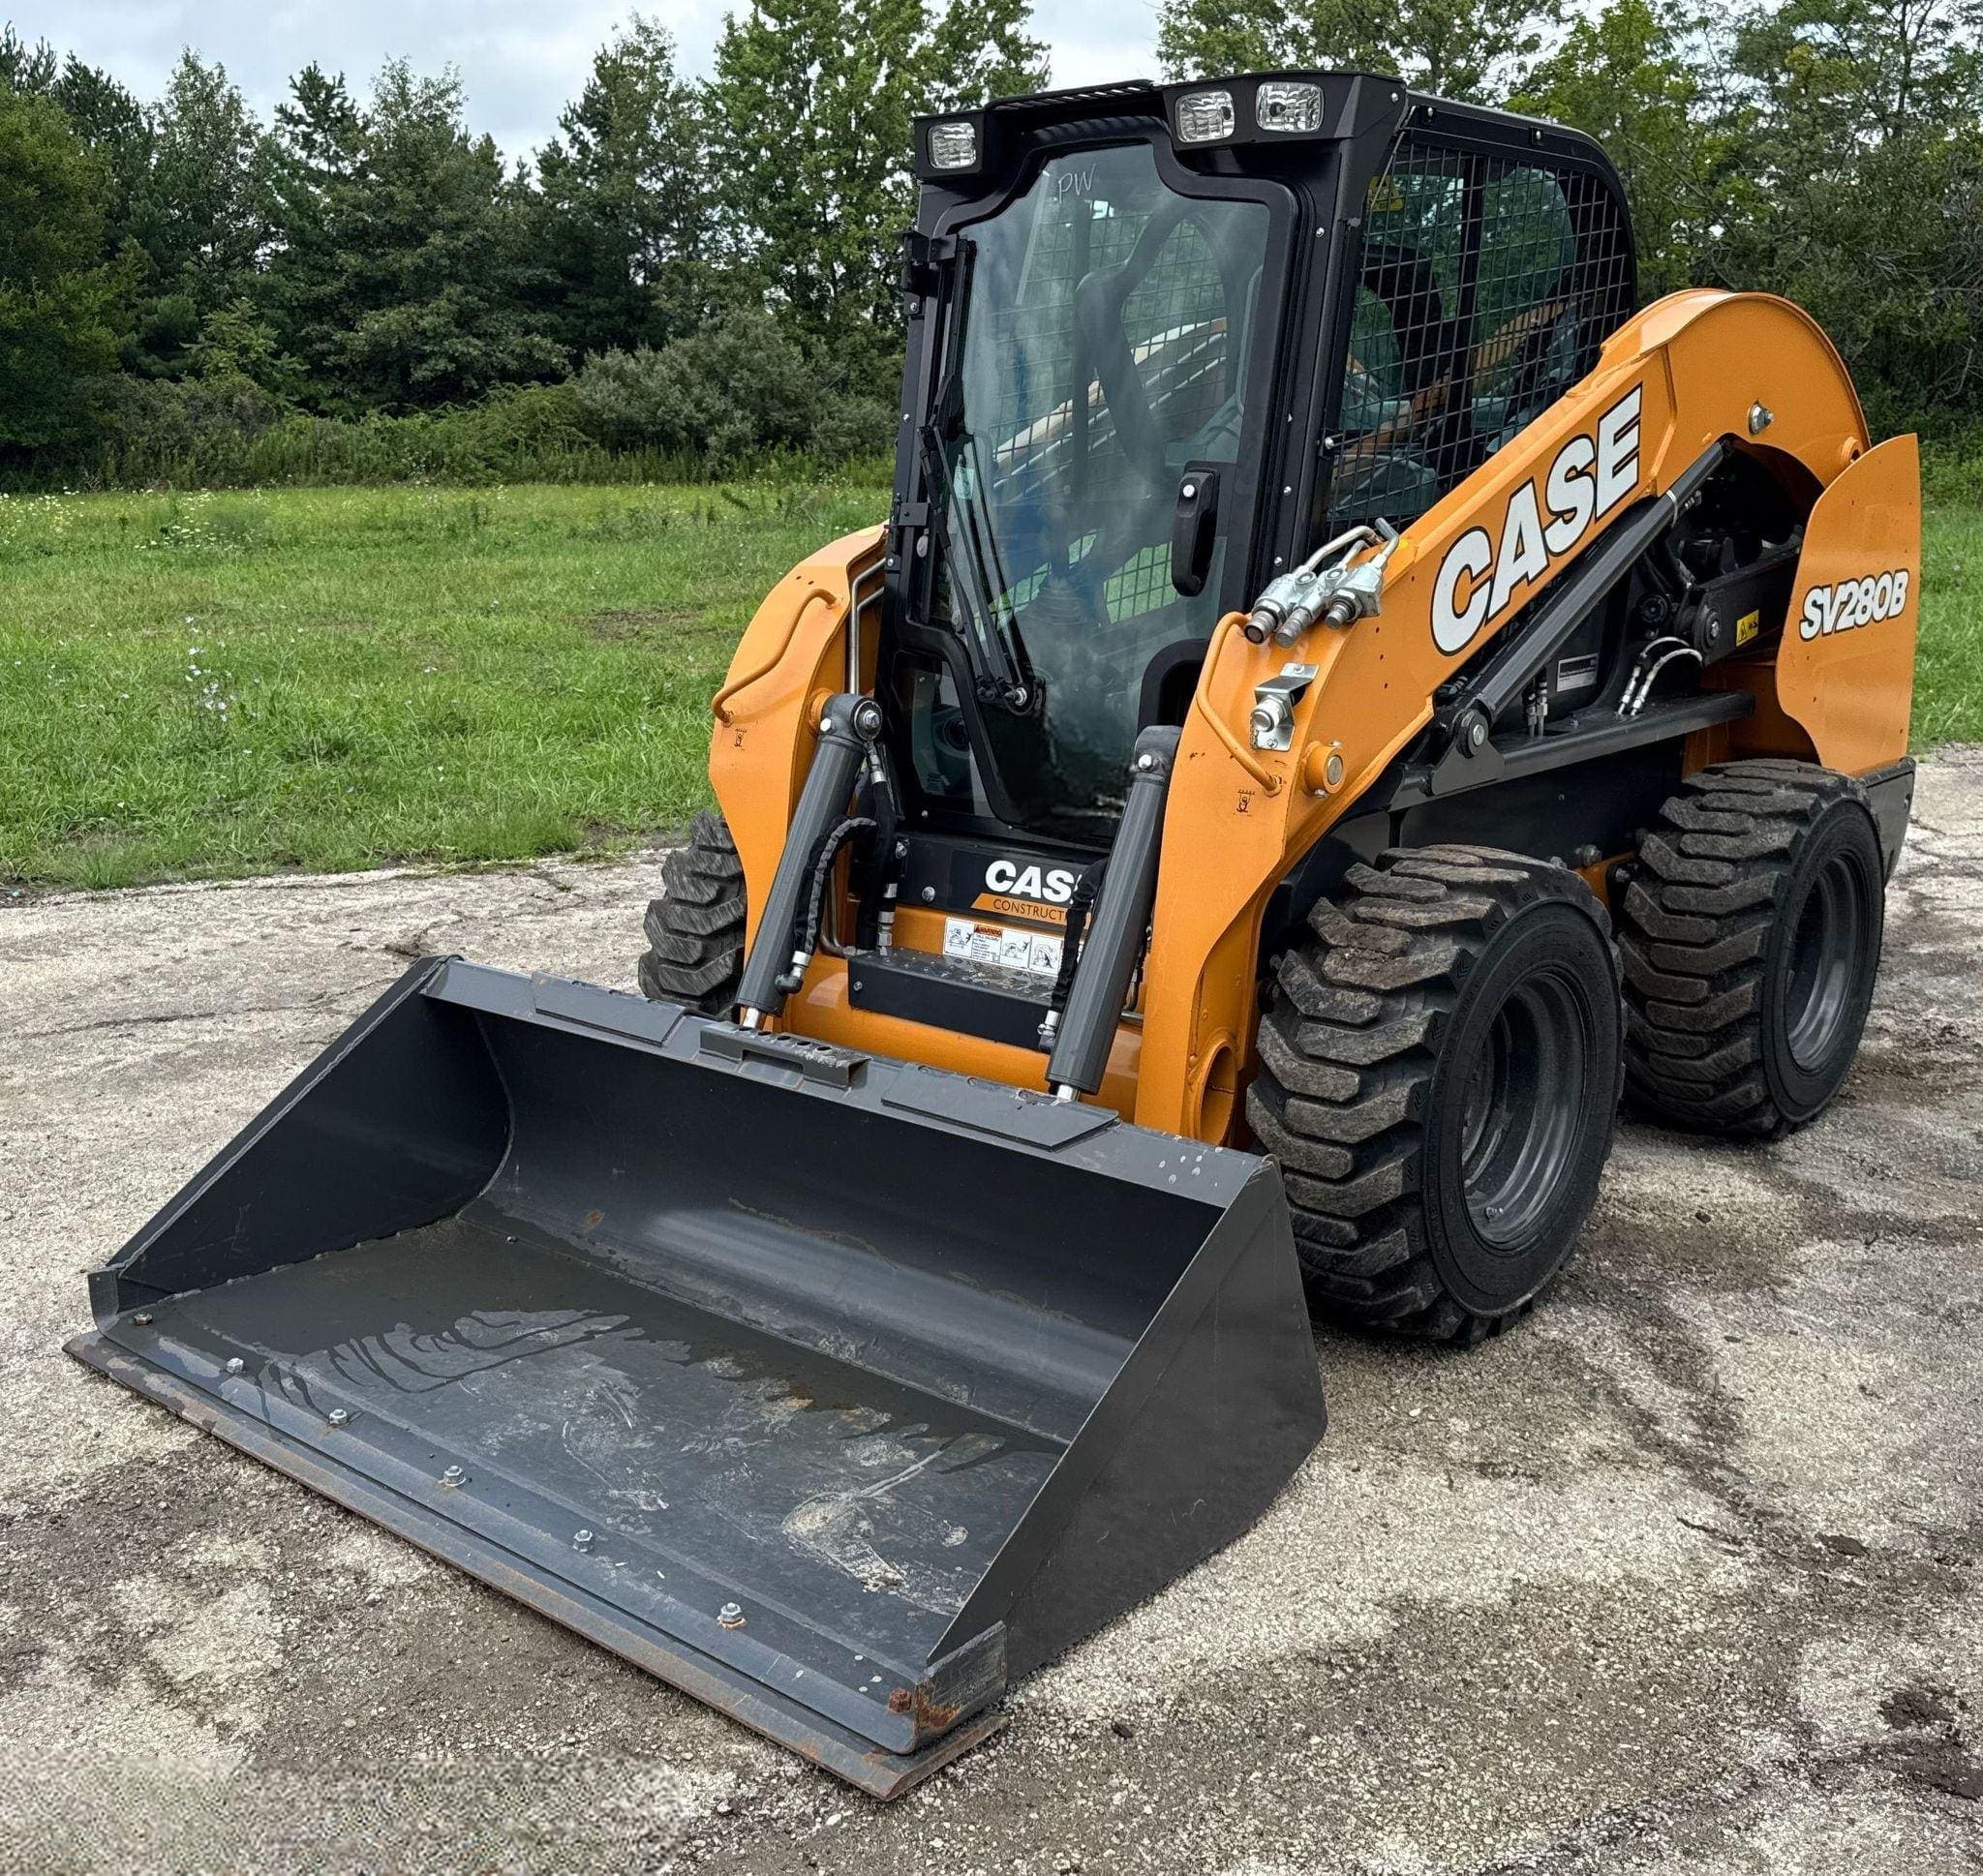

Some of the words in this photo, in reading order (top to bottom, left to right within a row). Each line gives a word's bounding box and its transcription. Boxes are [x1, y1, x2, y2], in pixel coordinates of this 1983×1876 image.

[1058, 163, 1096, 204] PW
[1430, 381, 1643, 656] CASE
[1800, 568, 1909, 642] SV280B
[985, 860, 1083, 904] CAS
[993, 898, 1065, 922] CONSTRUCT
